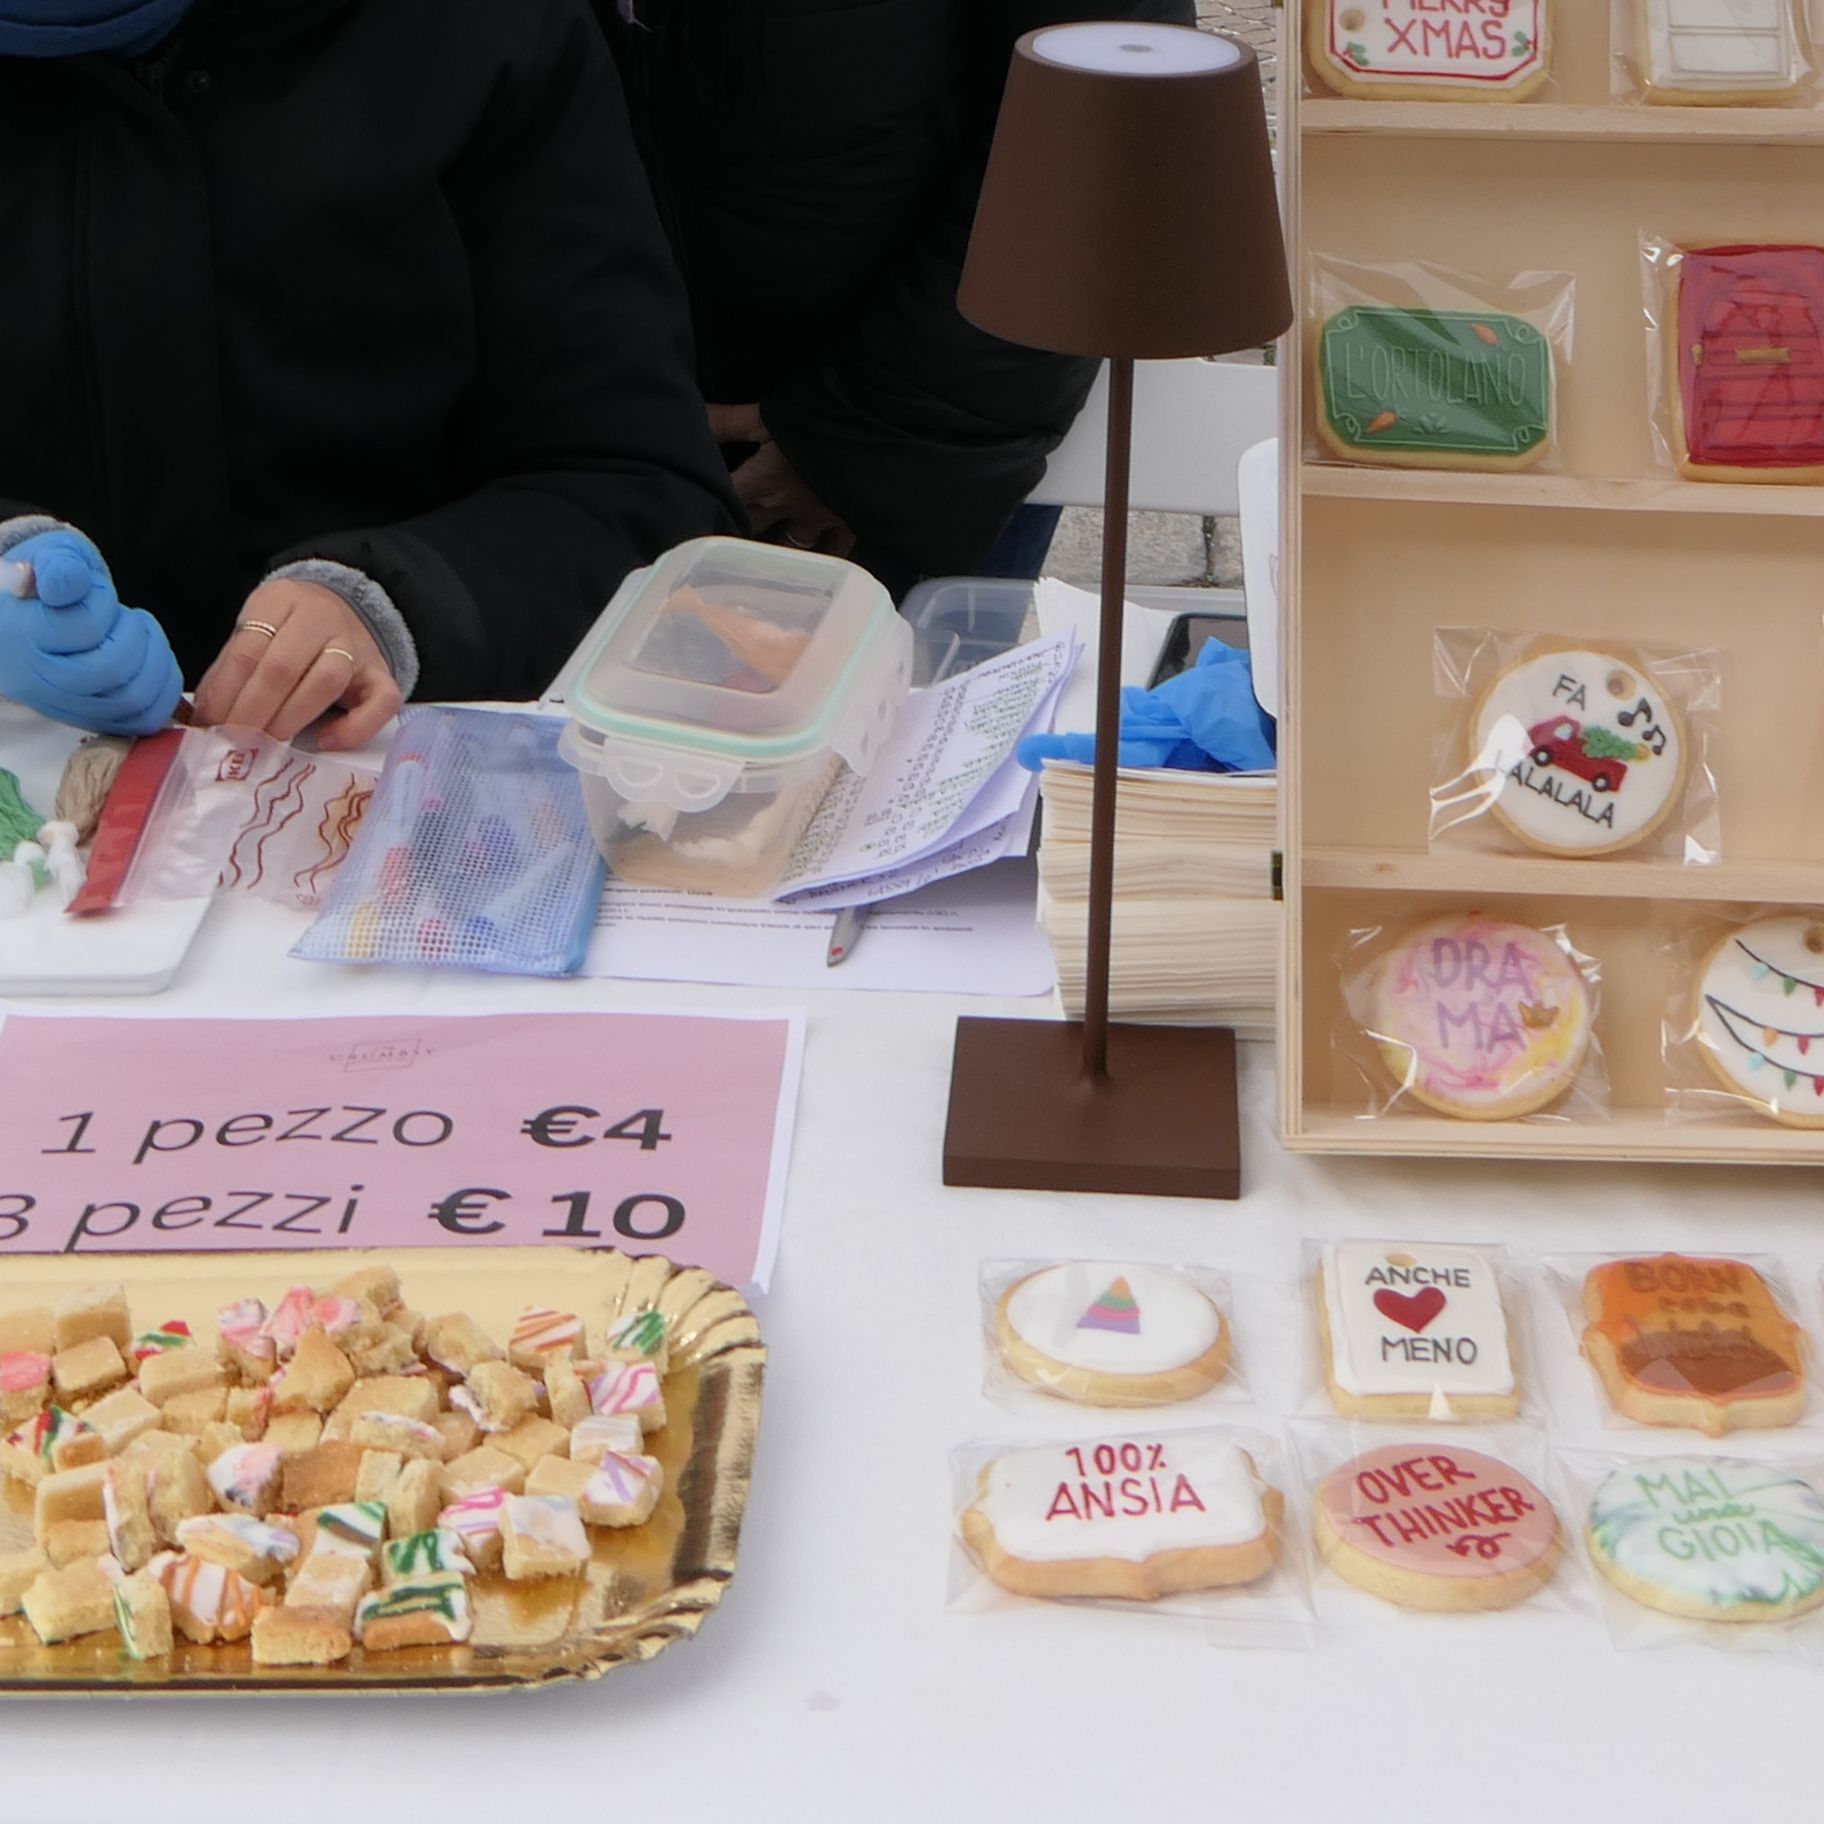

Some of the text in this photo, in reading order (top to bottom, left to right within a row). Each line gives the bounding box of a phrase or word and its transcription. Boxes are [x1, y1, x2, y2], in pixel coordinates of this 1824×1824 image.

[1383, 17, 1508, 60] XMAS
[1345, 343, 1526, 407] L'ORTOLANO
[1552, 673, 1587, 712] FA
[1432, 937, 1536, 1001] DRA
[1437, 1001, 1527, 1054] MA
[40, 1105, 673, 1166] 1 pezzo €4
[64, 1183, 365, 1250] pezzi
[427, 1188, 513, 1237] €
[541, 1191, 688, 1241] 10
[1364, 1265, 1471, 1288] ANCHE
[1624, 1260, 1744, 1295] BORN
[1381, 1335, 1479, 1366] MENO
[1065, 1441, 1169, 1478] 100%
[1351, 1455, 1477, 1507] OVER
[1044, 1472, 1208, 1523] ANSIA
[1635, 1467, 1729, 1508] MAI
[1354, 1486, 1536, 1550] THINKER
[1672, 1503, 1757, 1526] una
[1658, 1519, 1796, 1562] GIOIA
